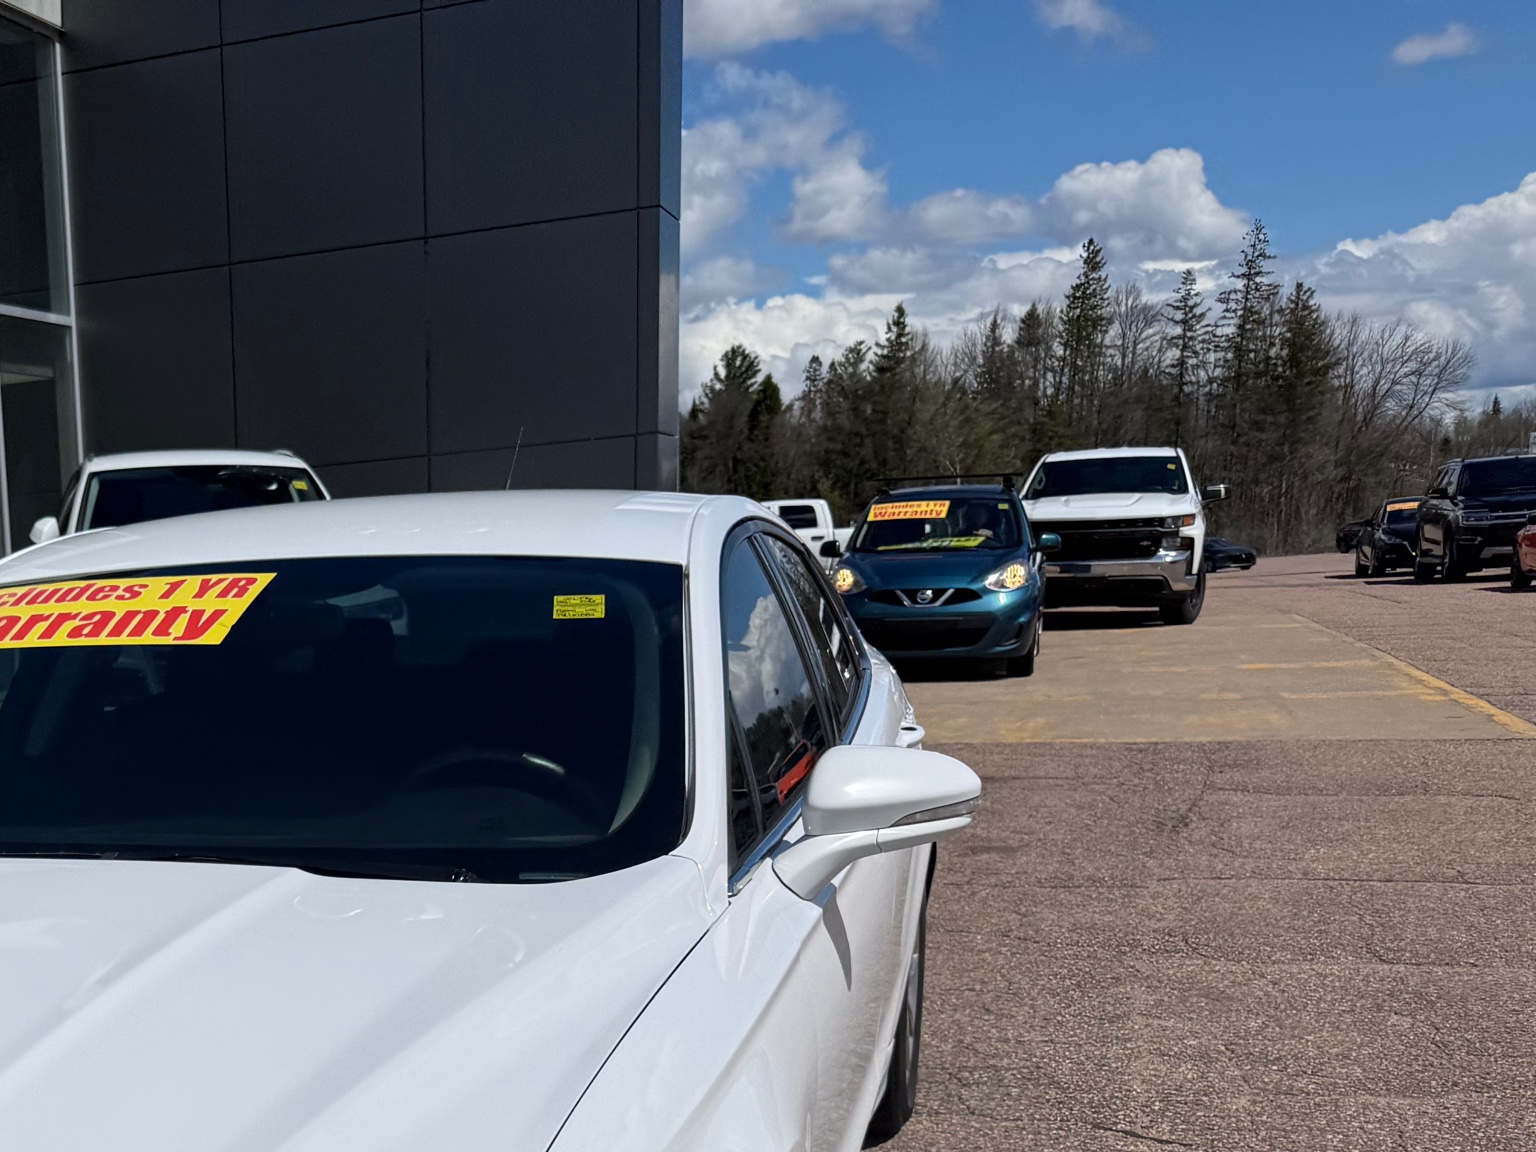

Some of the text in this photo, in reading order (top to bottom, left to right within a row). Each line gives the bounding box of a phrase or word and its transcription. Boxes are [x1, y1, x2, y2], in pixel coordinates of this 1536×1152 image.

[873, 509, 943, 518] Warranty
[158, 579, 188, 600] 1
[191, 577, 258, 599] YR
